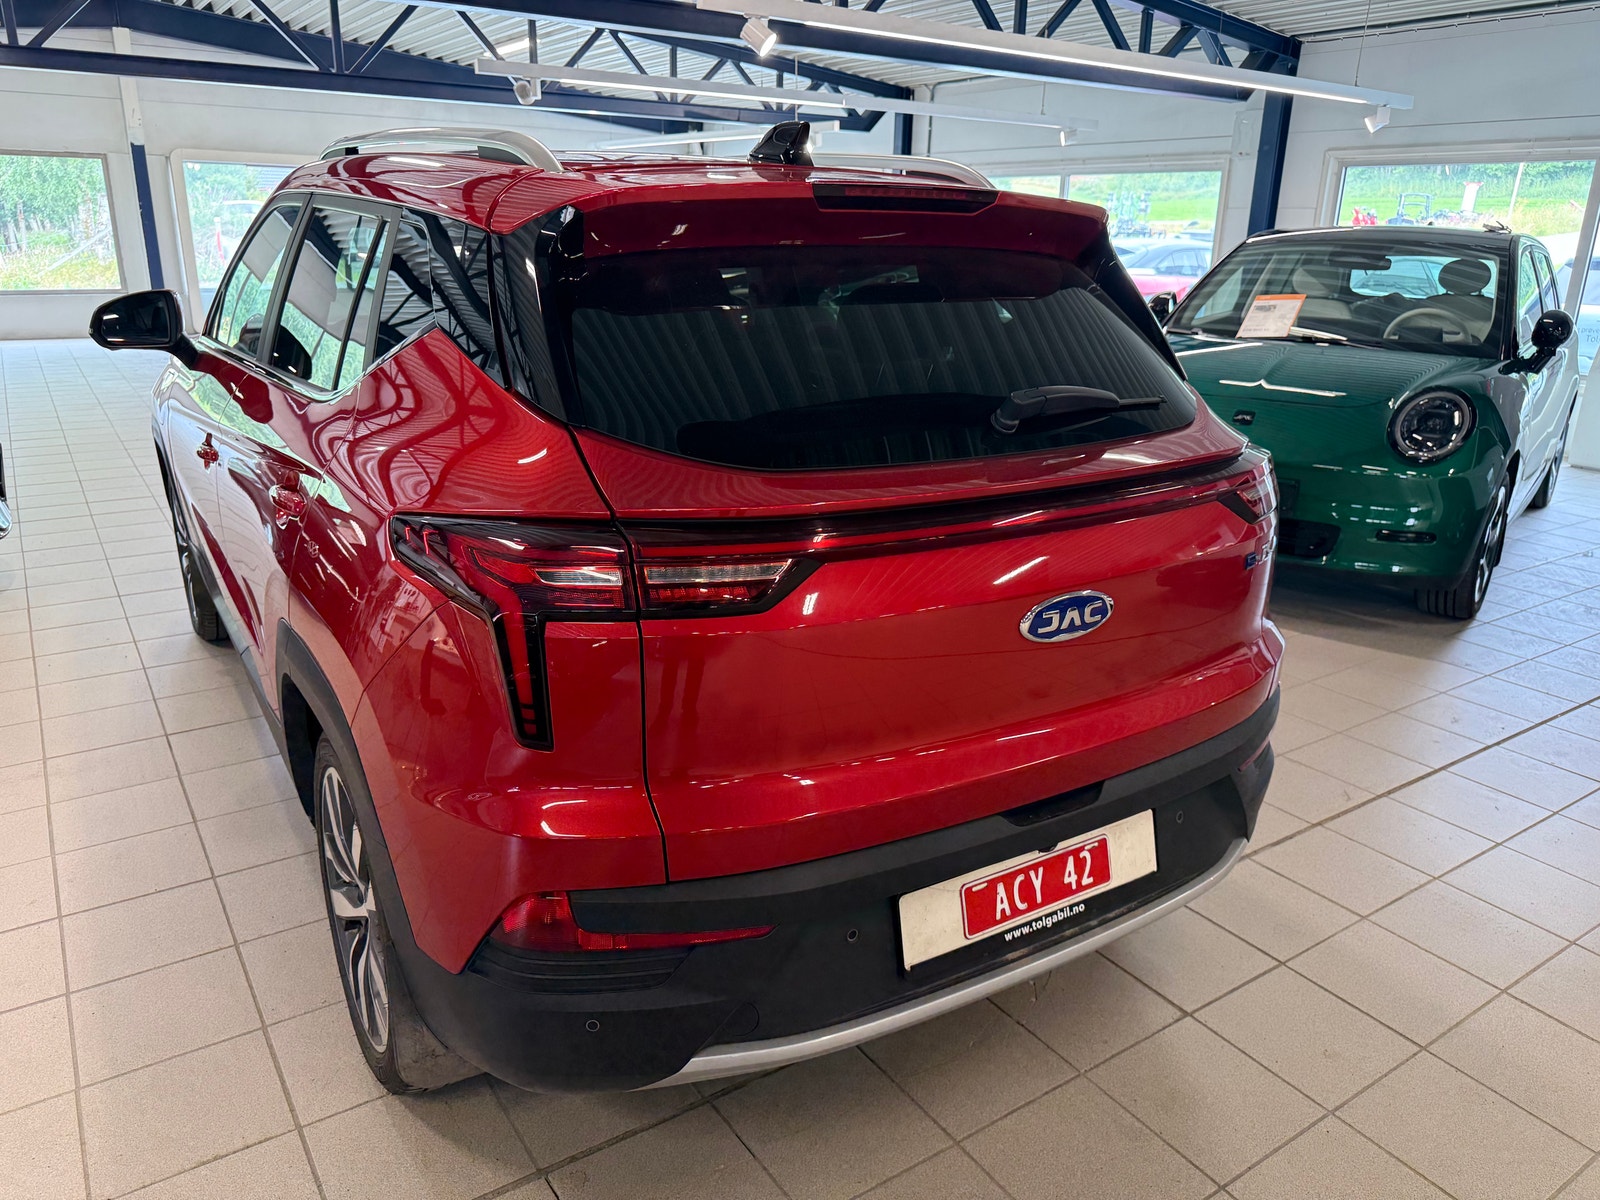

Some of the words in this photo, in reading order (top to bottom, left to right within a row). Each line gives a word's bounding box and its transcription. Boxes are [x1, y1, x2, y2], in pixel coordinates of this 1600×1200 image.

[1037, 601, 1103, 634] JAC
[995, 866, 1044, 920] ACY
[1063, 849, 1094, 890] 42
[1004, 903, 1086, 942] www.tolgabil.no
